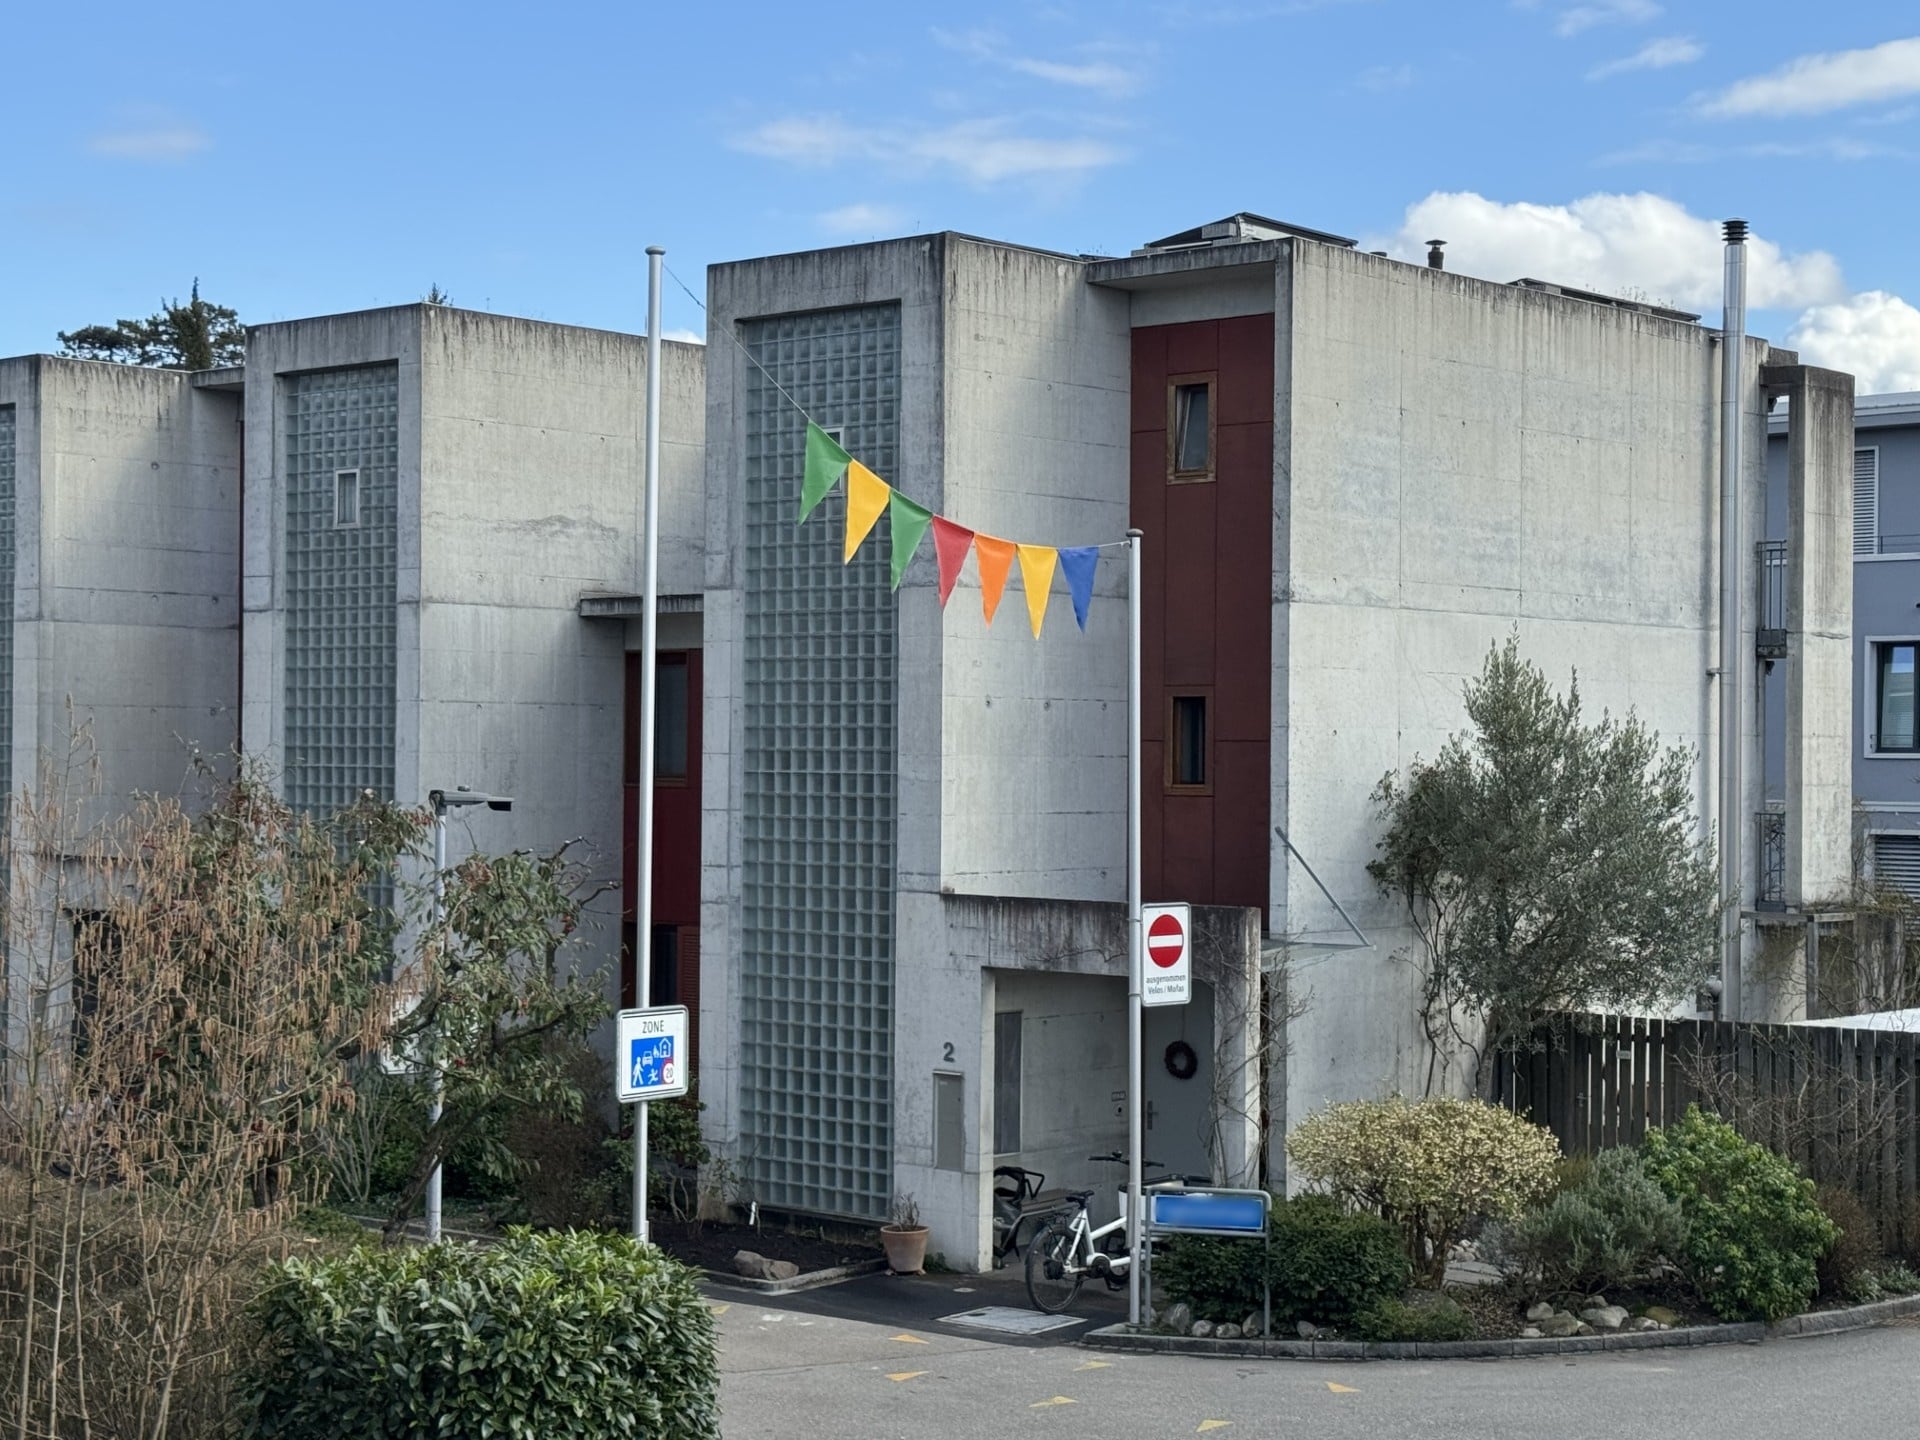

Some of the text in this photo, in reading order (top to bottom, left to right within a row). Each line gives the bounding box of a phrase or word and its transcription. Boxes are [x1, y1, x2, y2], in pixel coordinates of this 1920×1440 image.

[642, 1020, 664, 1034] ZONE
[943, 1041, 955, 1063] 2
[665, 1066, 673, 1079] 20
